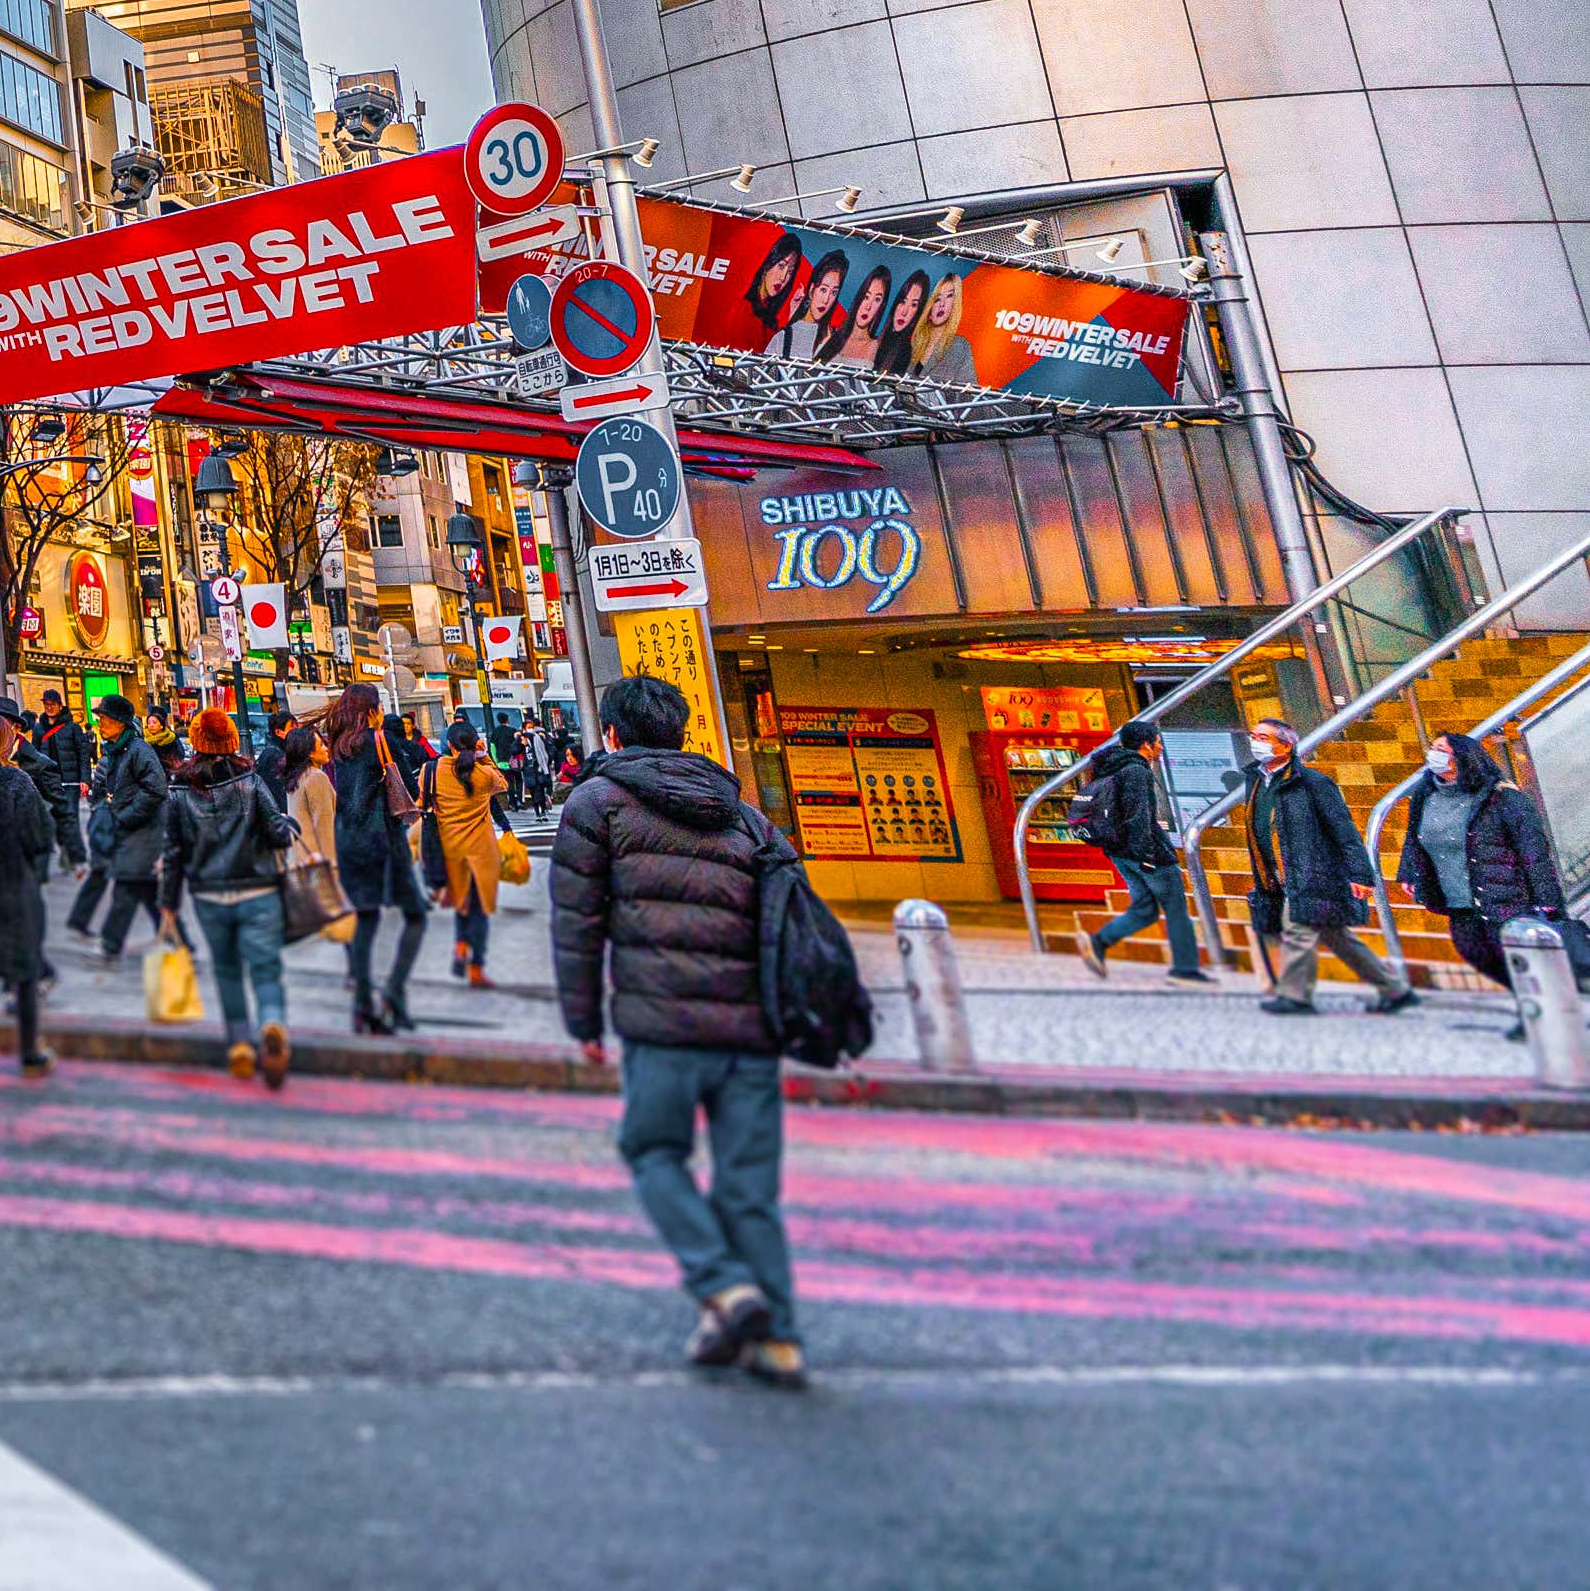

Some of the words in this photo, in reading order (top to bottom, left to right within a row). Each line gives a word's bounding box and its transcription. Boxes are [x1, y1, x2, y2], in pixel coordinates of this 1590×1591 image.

[487, 131, 542, 186] 30
[249, 194, 454, 273] SALE
[524, 250, 551, 263] WITH
[656, 248, 730, 281] SALE
[575, 265, 608, 283] 20-7
[43, 313, 153, 362] RED
[148, 261, 380, 339] VELVET
[1011, 334, 1031, 344] WITH
[1027, 339, 1068, 359] RED
[1067, 344, 1140, 369] VELVET
[1114, 329, 1170, 355] SALE
[521, 373, 565, 393] ここから
[599, 424, 642, 446] 7-20
[597, 452, 638, 525] P
[633, 489, 661, 522] 40
[761, 486, 910, 525] SHIBUYA
[767, 519, 918, 612] 109
[78, 584, 103, 617] 楽園
[218, 582, 231, 599] 4
[152, 648, 161, 658] 5
[680, 619, 698, 682] この通り
[782, 721, 835, 731] SPECIAL
[839, 722, 885, 733] EVENT
[799, 713, 837, 721] WINTER
